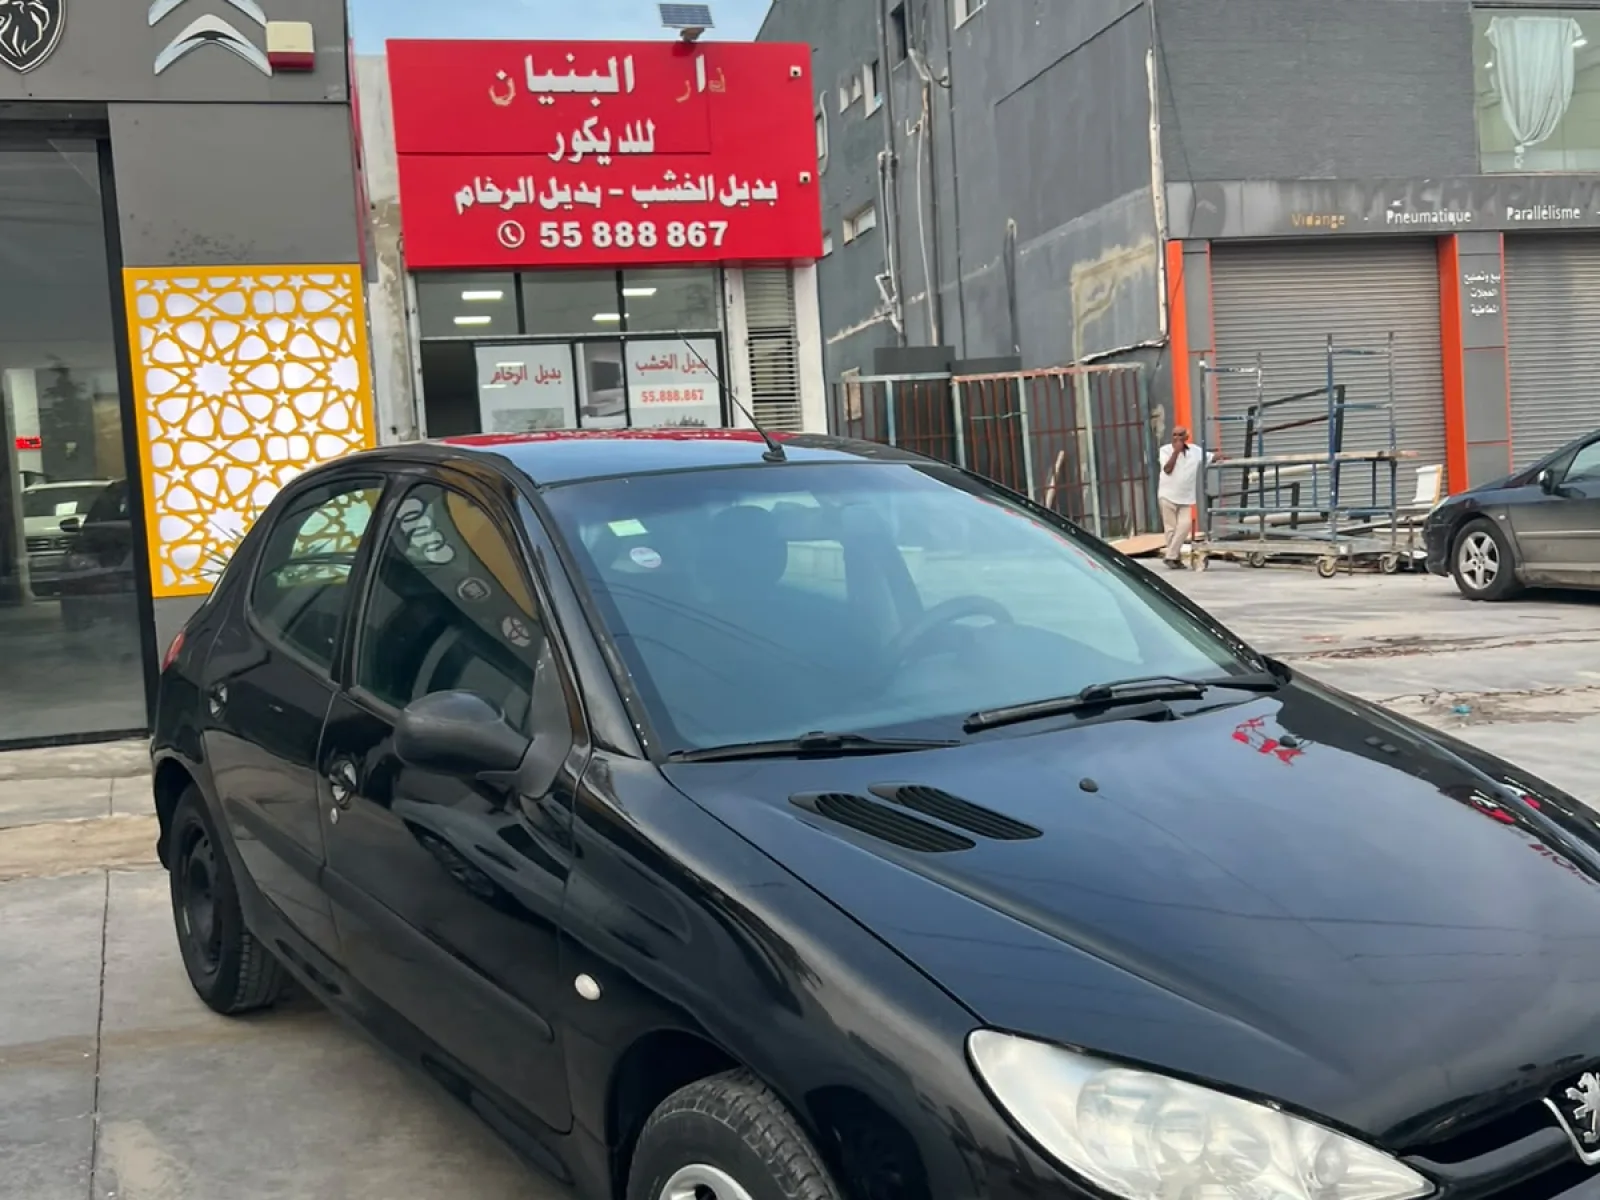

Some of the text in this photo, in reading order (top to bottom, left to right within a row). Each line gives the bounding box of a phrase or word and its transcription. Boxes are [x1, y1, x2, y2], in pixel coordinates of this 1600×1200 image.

[489, 52, 636, 107] البنيان
[548, 115, 656, 165] للديكور
[454, 175, 535, 215] الرخام
[539, 176, 602, 210] بديل
[631, 169, 715, 209] الخشب
[719, 173, 778, 207] بديل
[1291, 212, 1346, 230] Vidange
[1386, 207, 1472, 226] Pneumatique
[1506, 204, 1581, 221] Parallélisme
[540, 221, 729, 249] 55 888 867
[490, 364, 562, 386] بديل الرخام
[635, 353, 677, 376] الخشب
[641, 388, 704, 404] 55.888.867
